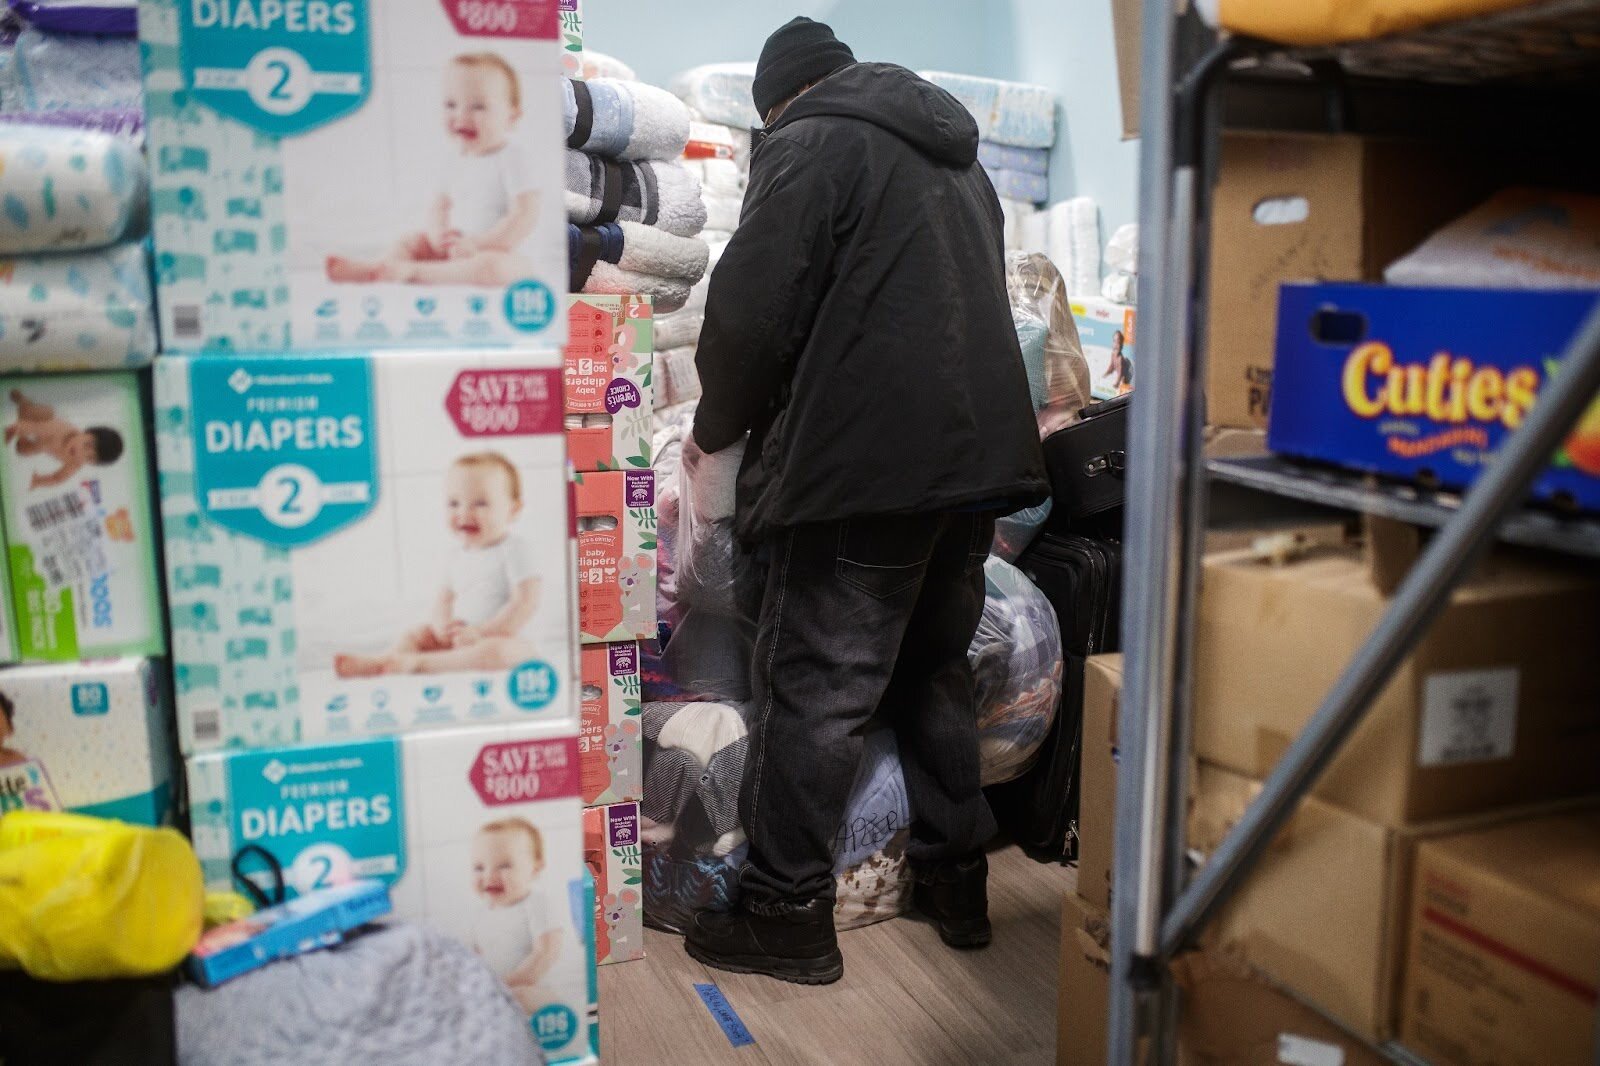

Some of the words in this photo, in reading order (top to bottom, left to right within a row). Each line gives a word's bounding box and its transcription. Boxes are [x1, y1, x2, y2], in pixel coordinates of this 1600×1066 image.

[192, 0, 356, 34] DIAPERS
[266, 61, 292, 99] 2
[629, 304, 640, 318] 2
[581, 360, 590, 369] 2
[459, 374, 524, 404] SAVE
[565, 376, 606, 387] diapers
[575, 387, 595, 395] baby
[609, 384, 631, 395] CHOICE
[1342, 341, 1539, 429] Cuties
[607, 391, 637, 408] Parent's
[206, 415, 364, 453] DIAPERS
[276, 477, 303, 514] 2
[592, 573, 600, 583] 2
[579, 725, 603, 737] pers
[483, 745, 544, 776] SAVE
[484, 772, 540, 802] $800
[241, 794, 392, 840] DIAPERS
[309, 856, 334, 889] 2
